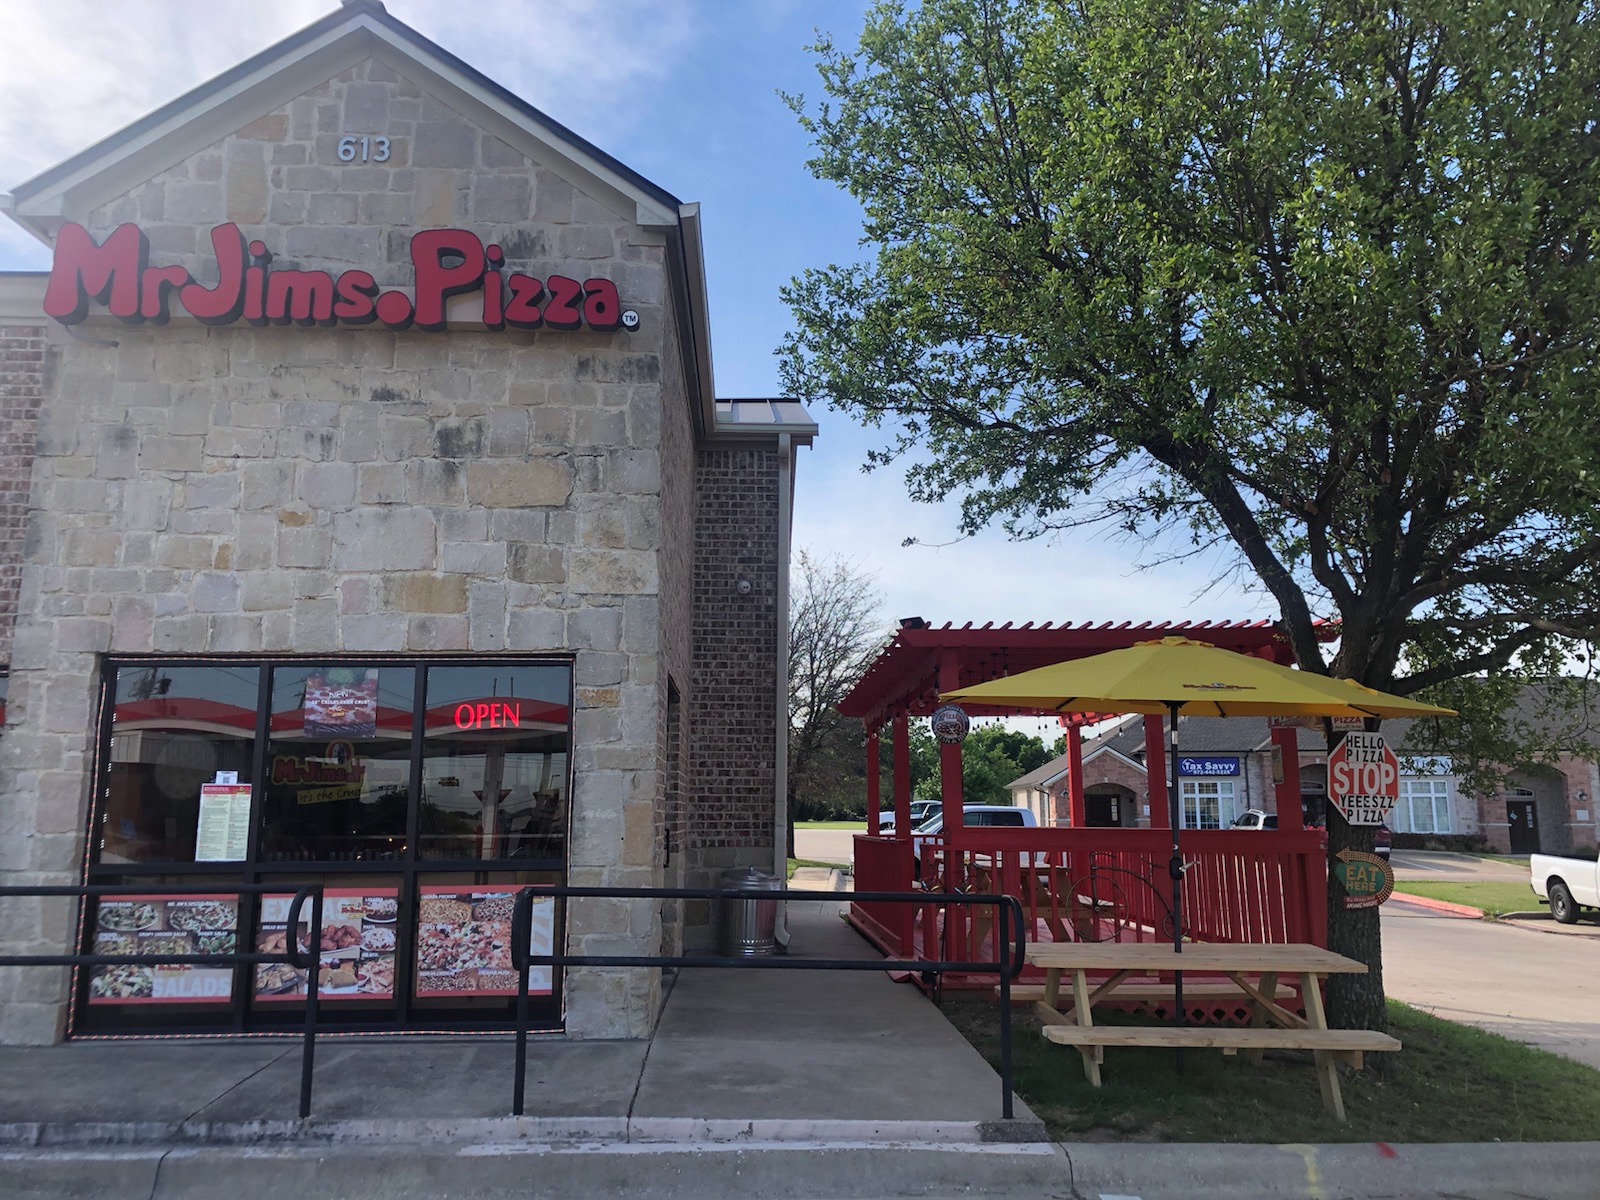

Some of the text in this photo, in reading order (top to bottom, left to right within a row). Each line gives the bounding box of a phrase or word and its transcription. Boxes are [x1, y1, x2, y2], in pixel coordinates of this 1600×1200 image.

[336, 135, 391, 163] 613
[454, 703, 519, 729] OPEN
[1333, 716, 1361, 724] PIZZA
[1346, 735, 1384, 749] HELLO
[1346, 748, 1384, 763] PIZZA
[1185, 761, 1235, 772] Tax Savvy
[1333, 761, 1395, 795] STOP
[1347, 809, 1384, 823] PIZZA
[1346, 865, 1378, 881] EAT
[1345, 881, 1376, 892] HERE
[152, 976, 230, 997] SALADS
